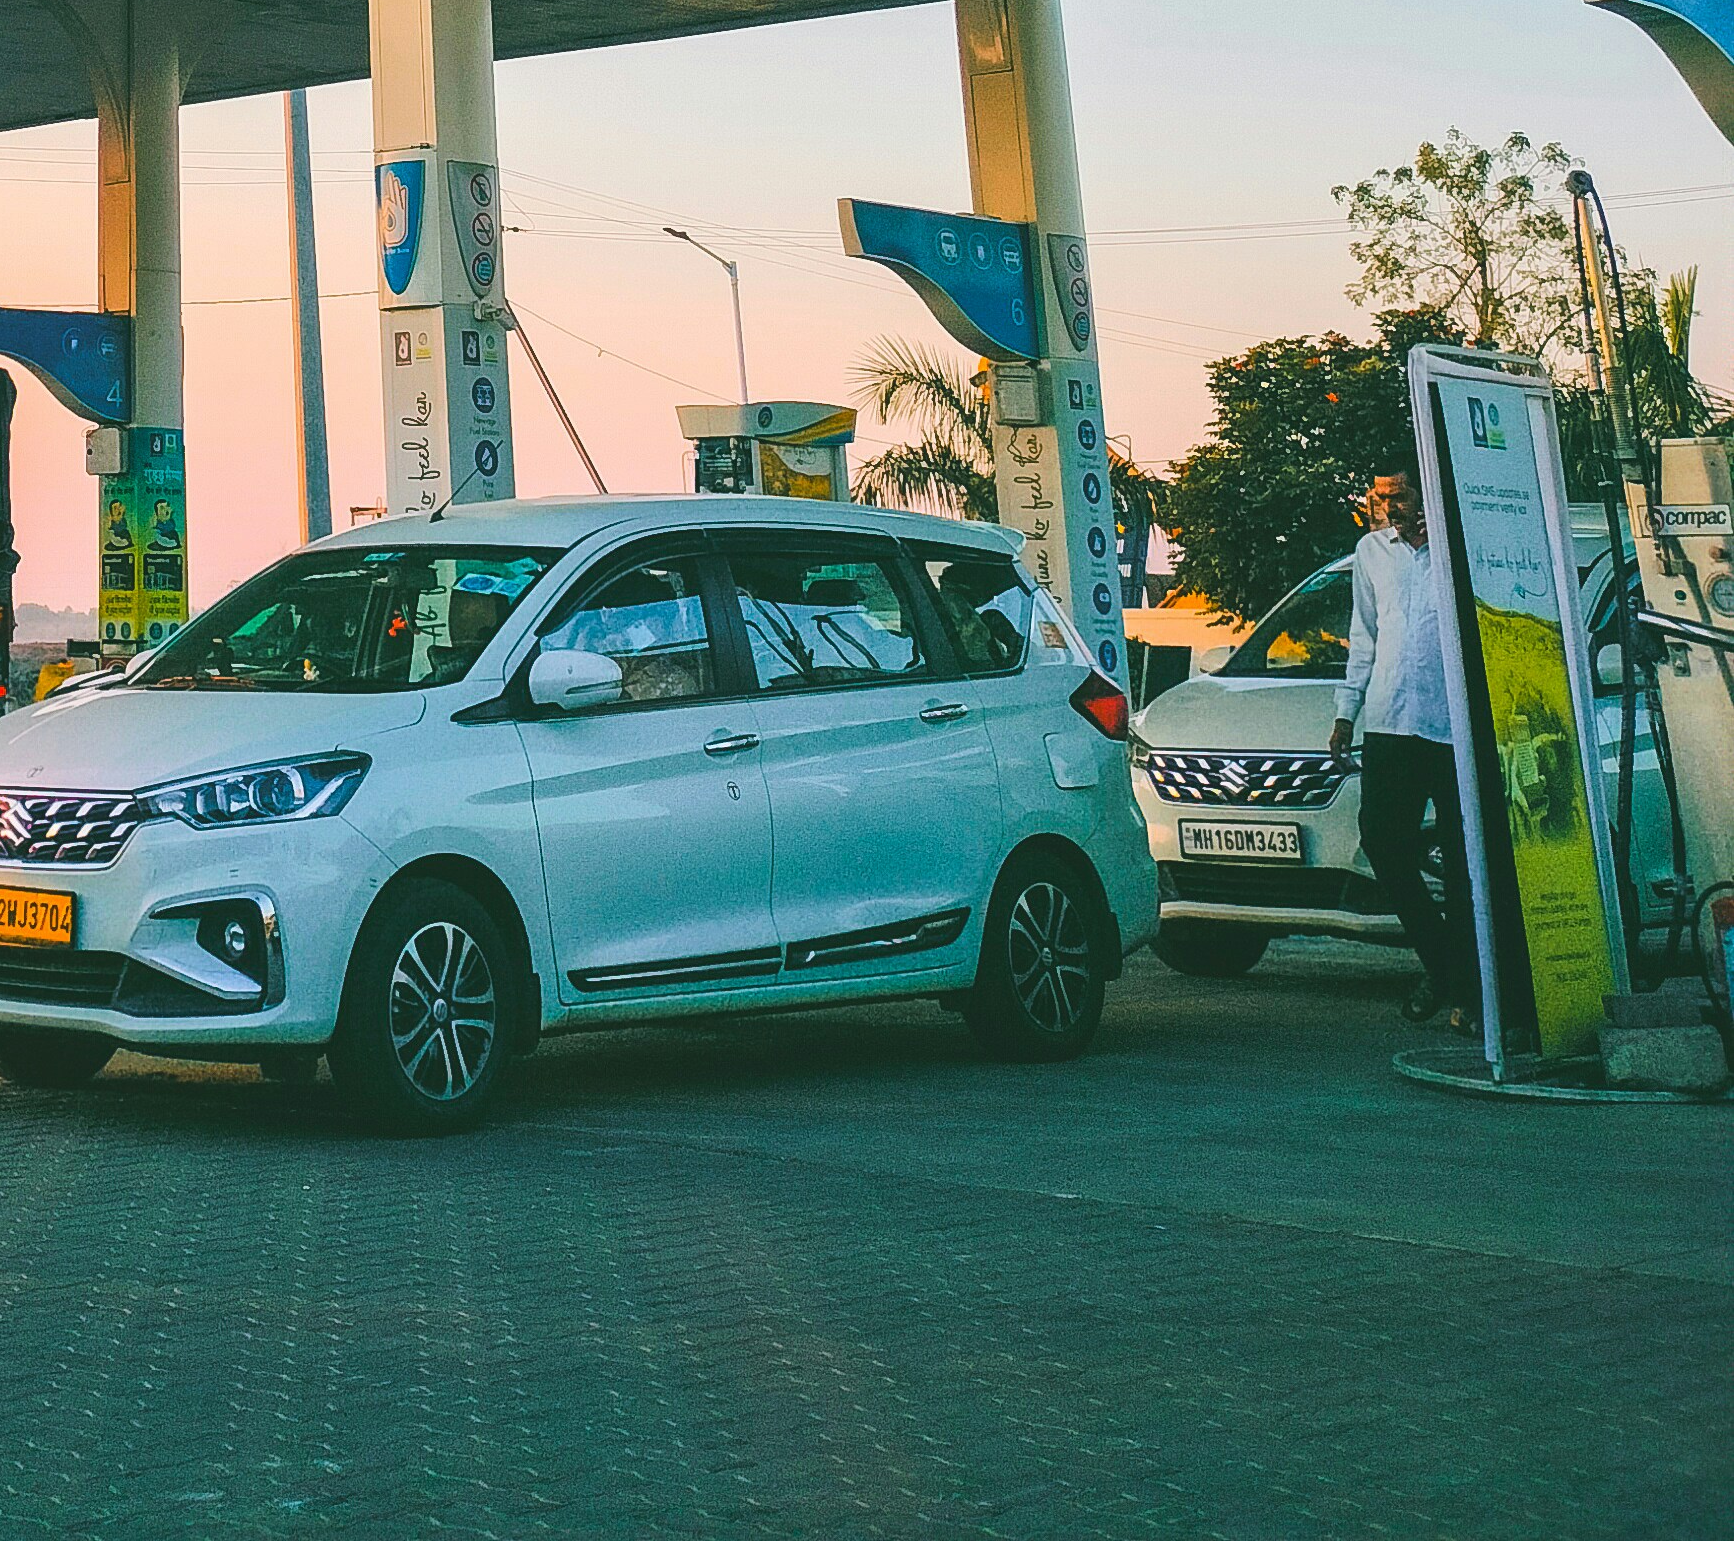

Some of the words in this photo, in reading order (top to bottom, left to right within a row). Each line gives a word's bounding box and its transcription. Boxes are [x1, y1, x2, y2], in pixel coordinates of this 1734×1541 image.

[1011, 298, 1025, 326] 6
[106, 380, 124, 407] 4
[1665, 509, 1727, 529] compac
[1192, 828, 1298, 853] MH16DM3433
